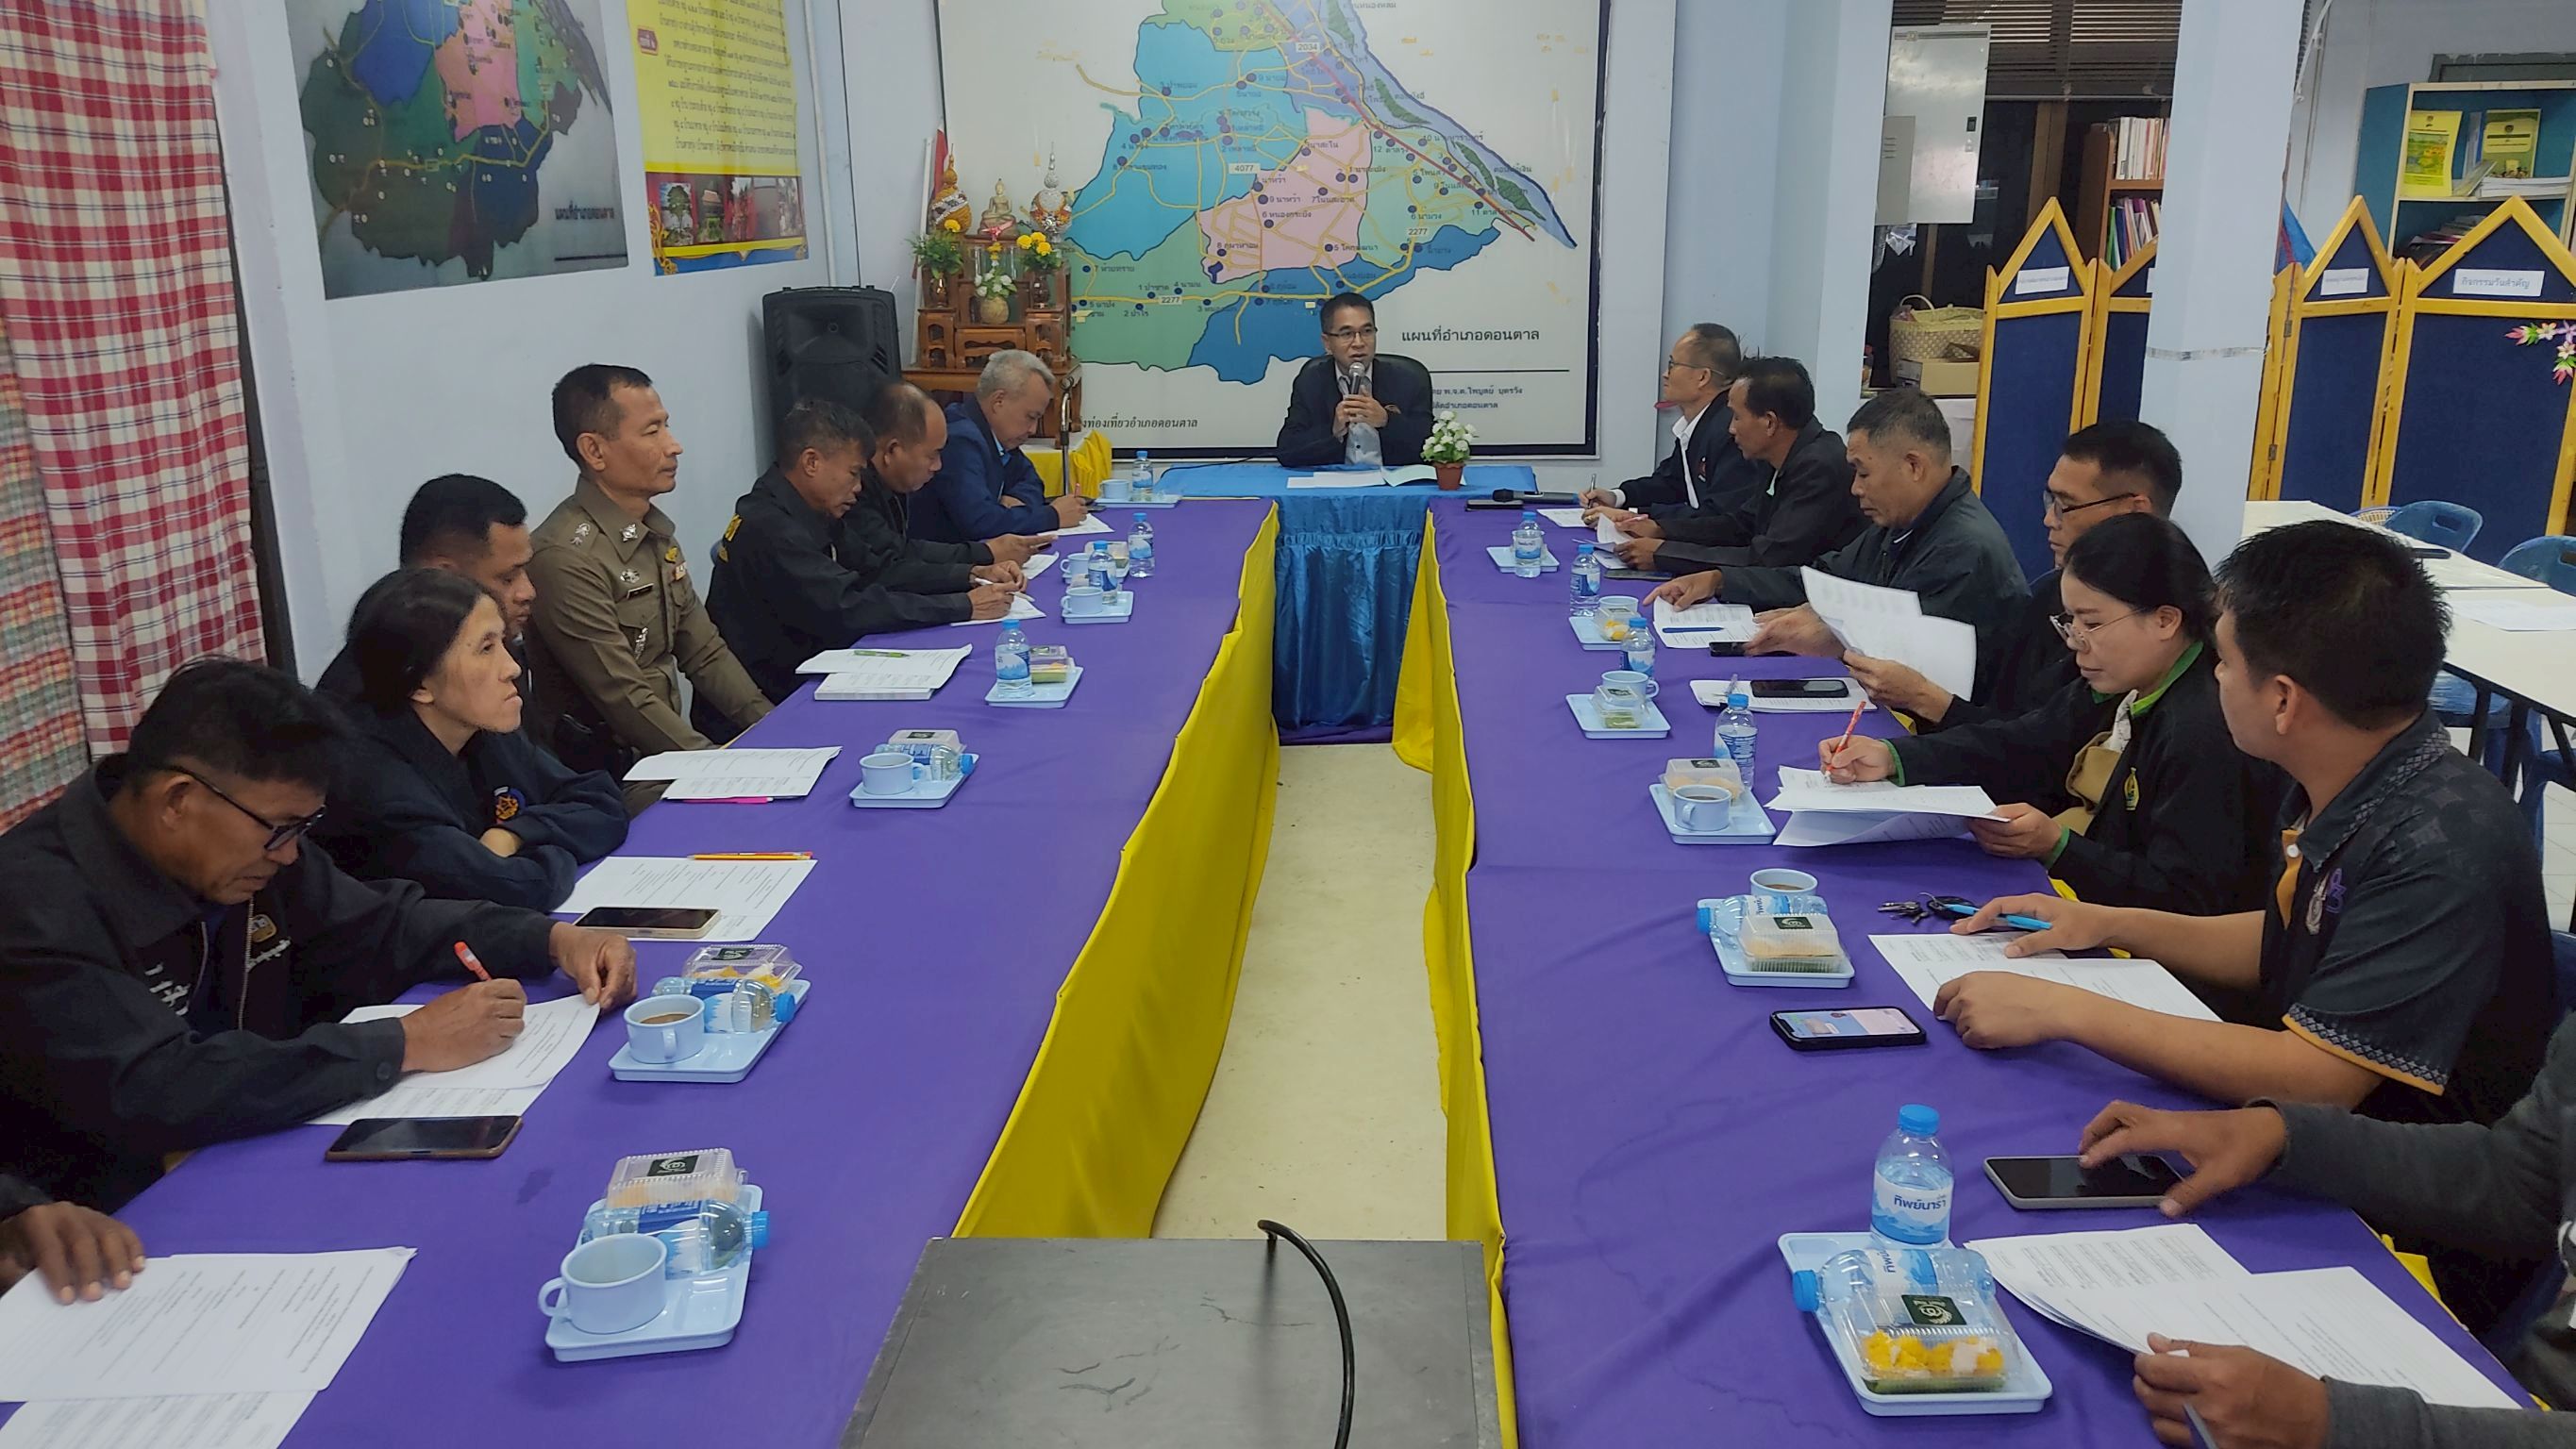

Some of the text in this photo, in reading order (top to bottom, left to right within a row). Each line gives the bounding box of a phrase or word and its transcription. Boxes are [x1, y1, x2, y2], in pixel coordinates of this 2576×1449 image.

[1297, 42, 1319, 52] 2034
[1234, 164, 1255, 173] 4077
[1162, 296, 1181, 305] 2277
[1401, 325, 1540, 342] แผนที่อำเภอดอนตาล
